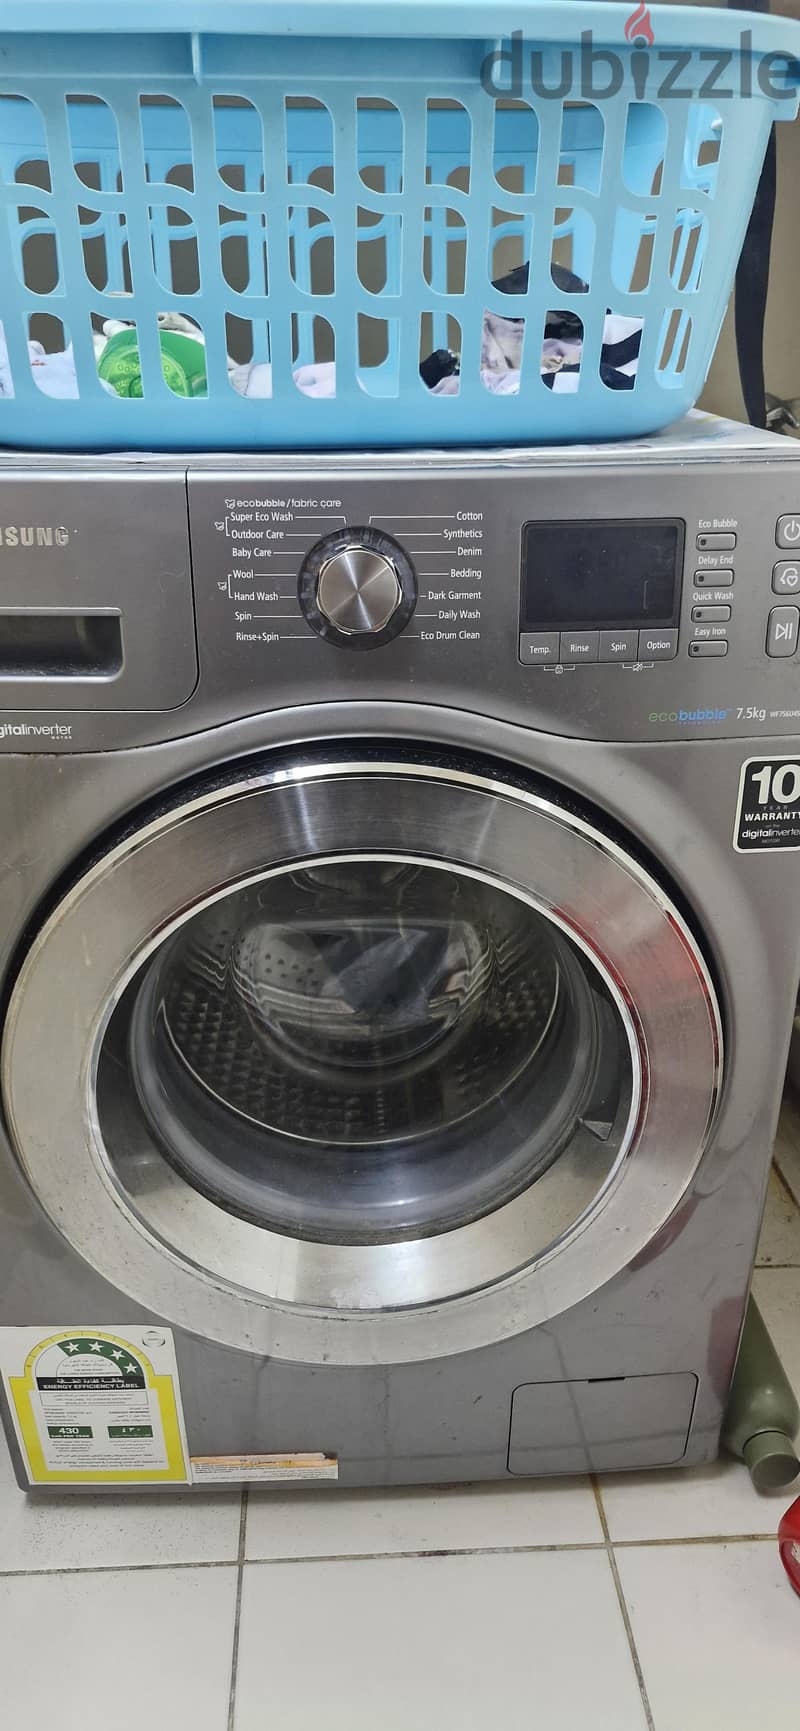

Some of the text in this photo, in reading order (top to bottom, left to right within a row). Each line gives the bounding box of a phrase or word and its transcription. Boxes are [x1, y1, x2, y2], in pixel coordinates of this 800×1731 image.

[320, 500, 342, 508] care
[230, 512, 294, 523] Super Eco Wash
[456, 511, 483, 521] Cotton
[698, 518, 738, 529] Eco Bubble
[0, 526, 69, 547] SUNG
[231, 530, 284, 539] Outdoor Care
[443, 528, 483, 541] Synthetics
[232, 548, 272, 558] Baby Care
[457, 546, 482, 556] Denim
[698, 554, 734, 567] Delay End
[232, 569, 254, 579] Wool
[450, 568, 482, 579] Bedding
[234, 591, 279, 601] Hand Wash
[428, 590, 481, 600] Dark Garment
[692, 591, 734, 603] Quick Wash
[234, 611, 252, 622] Spin
[438, 609, 481, 621] Daily Wash
[236, 631, 279, 643] Rinse+Spin
[420, 630, 481, 640] Eco Drum Clean
[694, 626, 727, 638] Easy Iron
[529, 645, 551, 655] Temp.
[569, 644, 589, 653] Rinse
[611, 642, 627, 652] Spin
[646, 640, 671, 650] Option
[648, 709, 728, 722] ecobubble
[736, 707, 767, 721] 7.5kg
[751, 764, 800, 805] 10
[58, 1427, 80, 1435] 430
